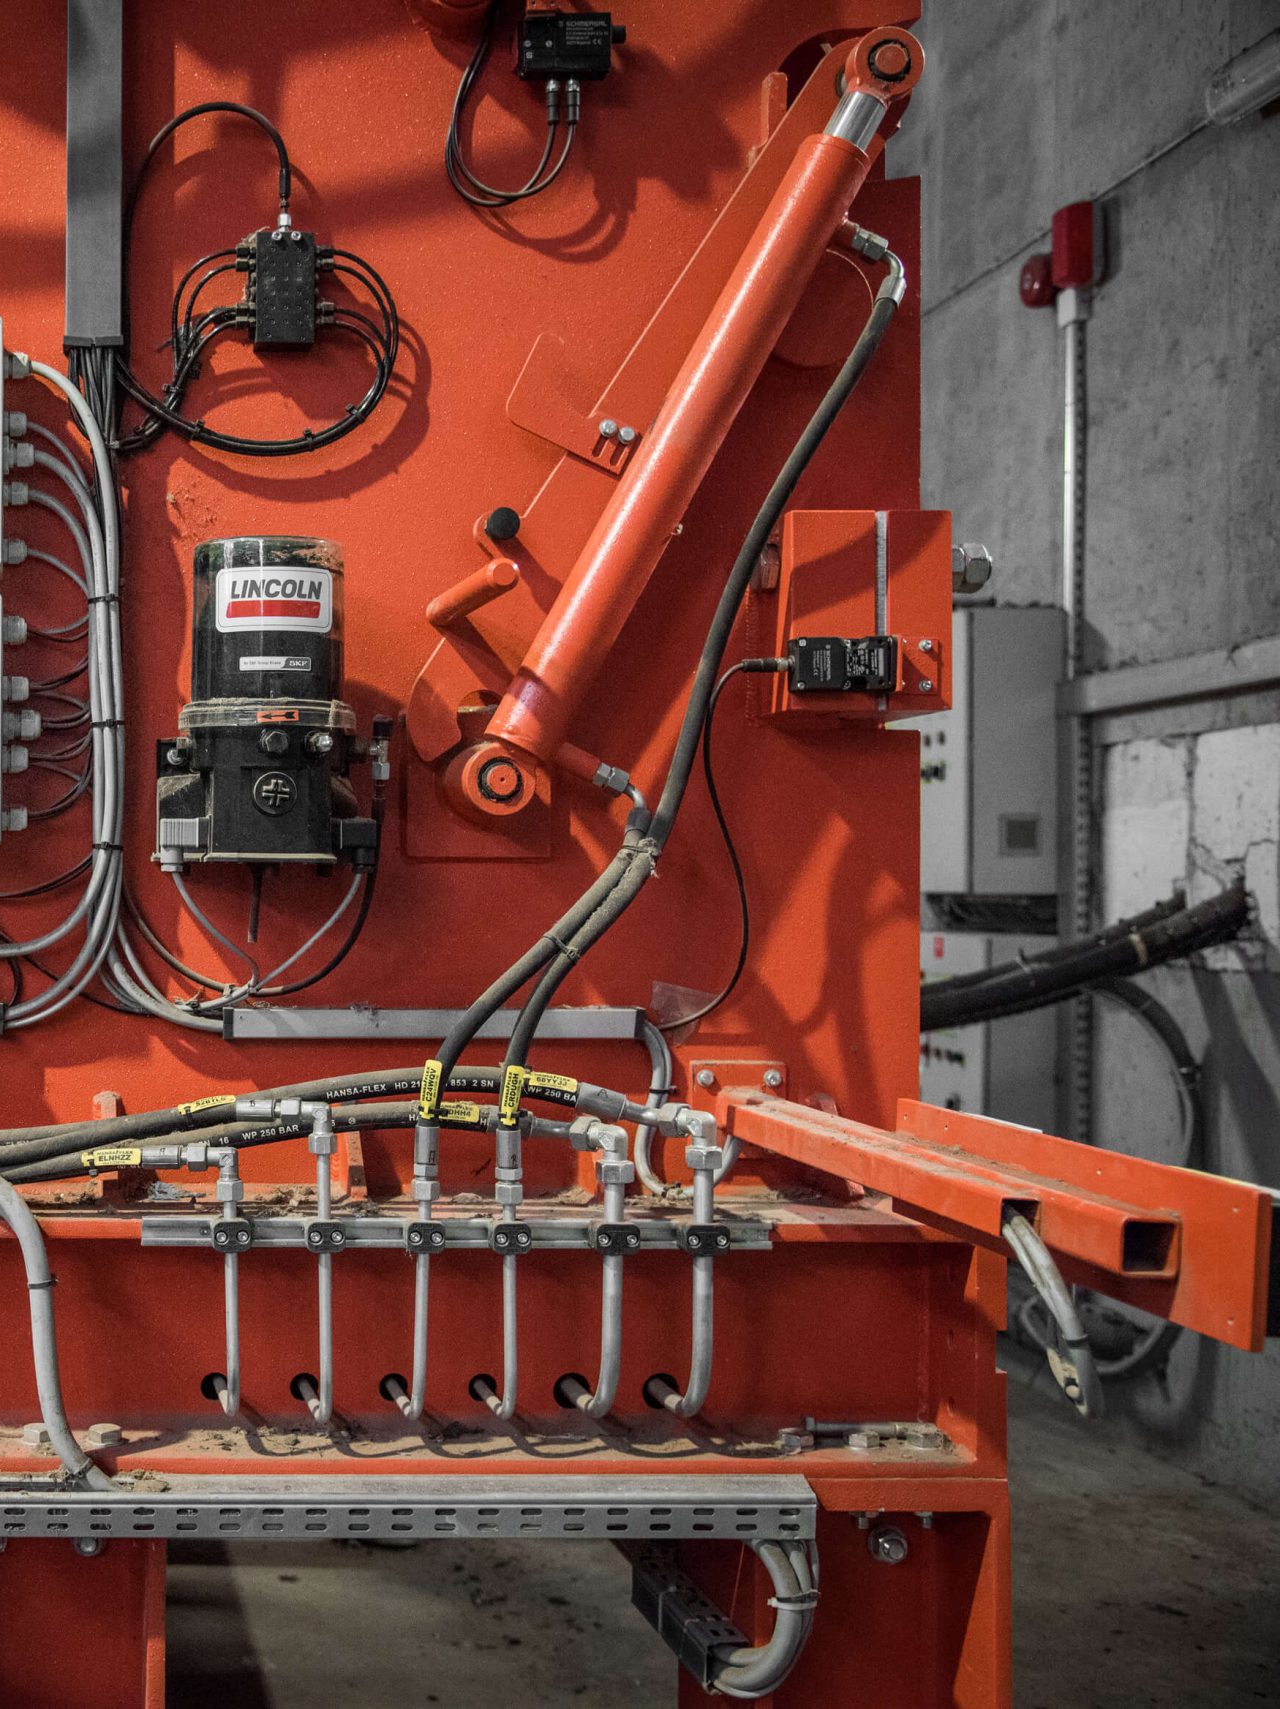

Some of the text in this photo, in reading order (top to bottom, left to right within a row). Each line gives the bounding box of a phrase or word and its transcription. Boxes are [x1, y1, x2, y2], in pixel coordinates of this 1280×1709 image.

[231, 579, 322, 600] LINCOLN
[326, 1083, 387, 1099] HANSA-FLEX
[394, 1082, 409, 1090] HD
[410, 1081, 421, 1089] 21
[450, 1079, 467, 1087] 853
[528, 1085, 542, 1093] WP
[544, 1088, 561, 1098] 250
[563, 1093, 577, 1103] BA
[425, 1068, 437, 1102] C24WQV
[219, 1136, 230, 1145] 16
[241, 1131, 258, 1141] WP
[260, 1128, 276, 1137] 250
[278, 1124, 300, 1134] BAR
